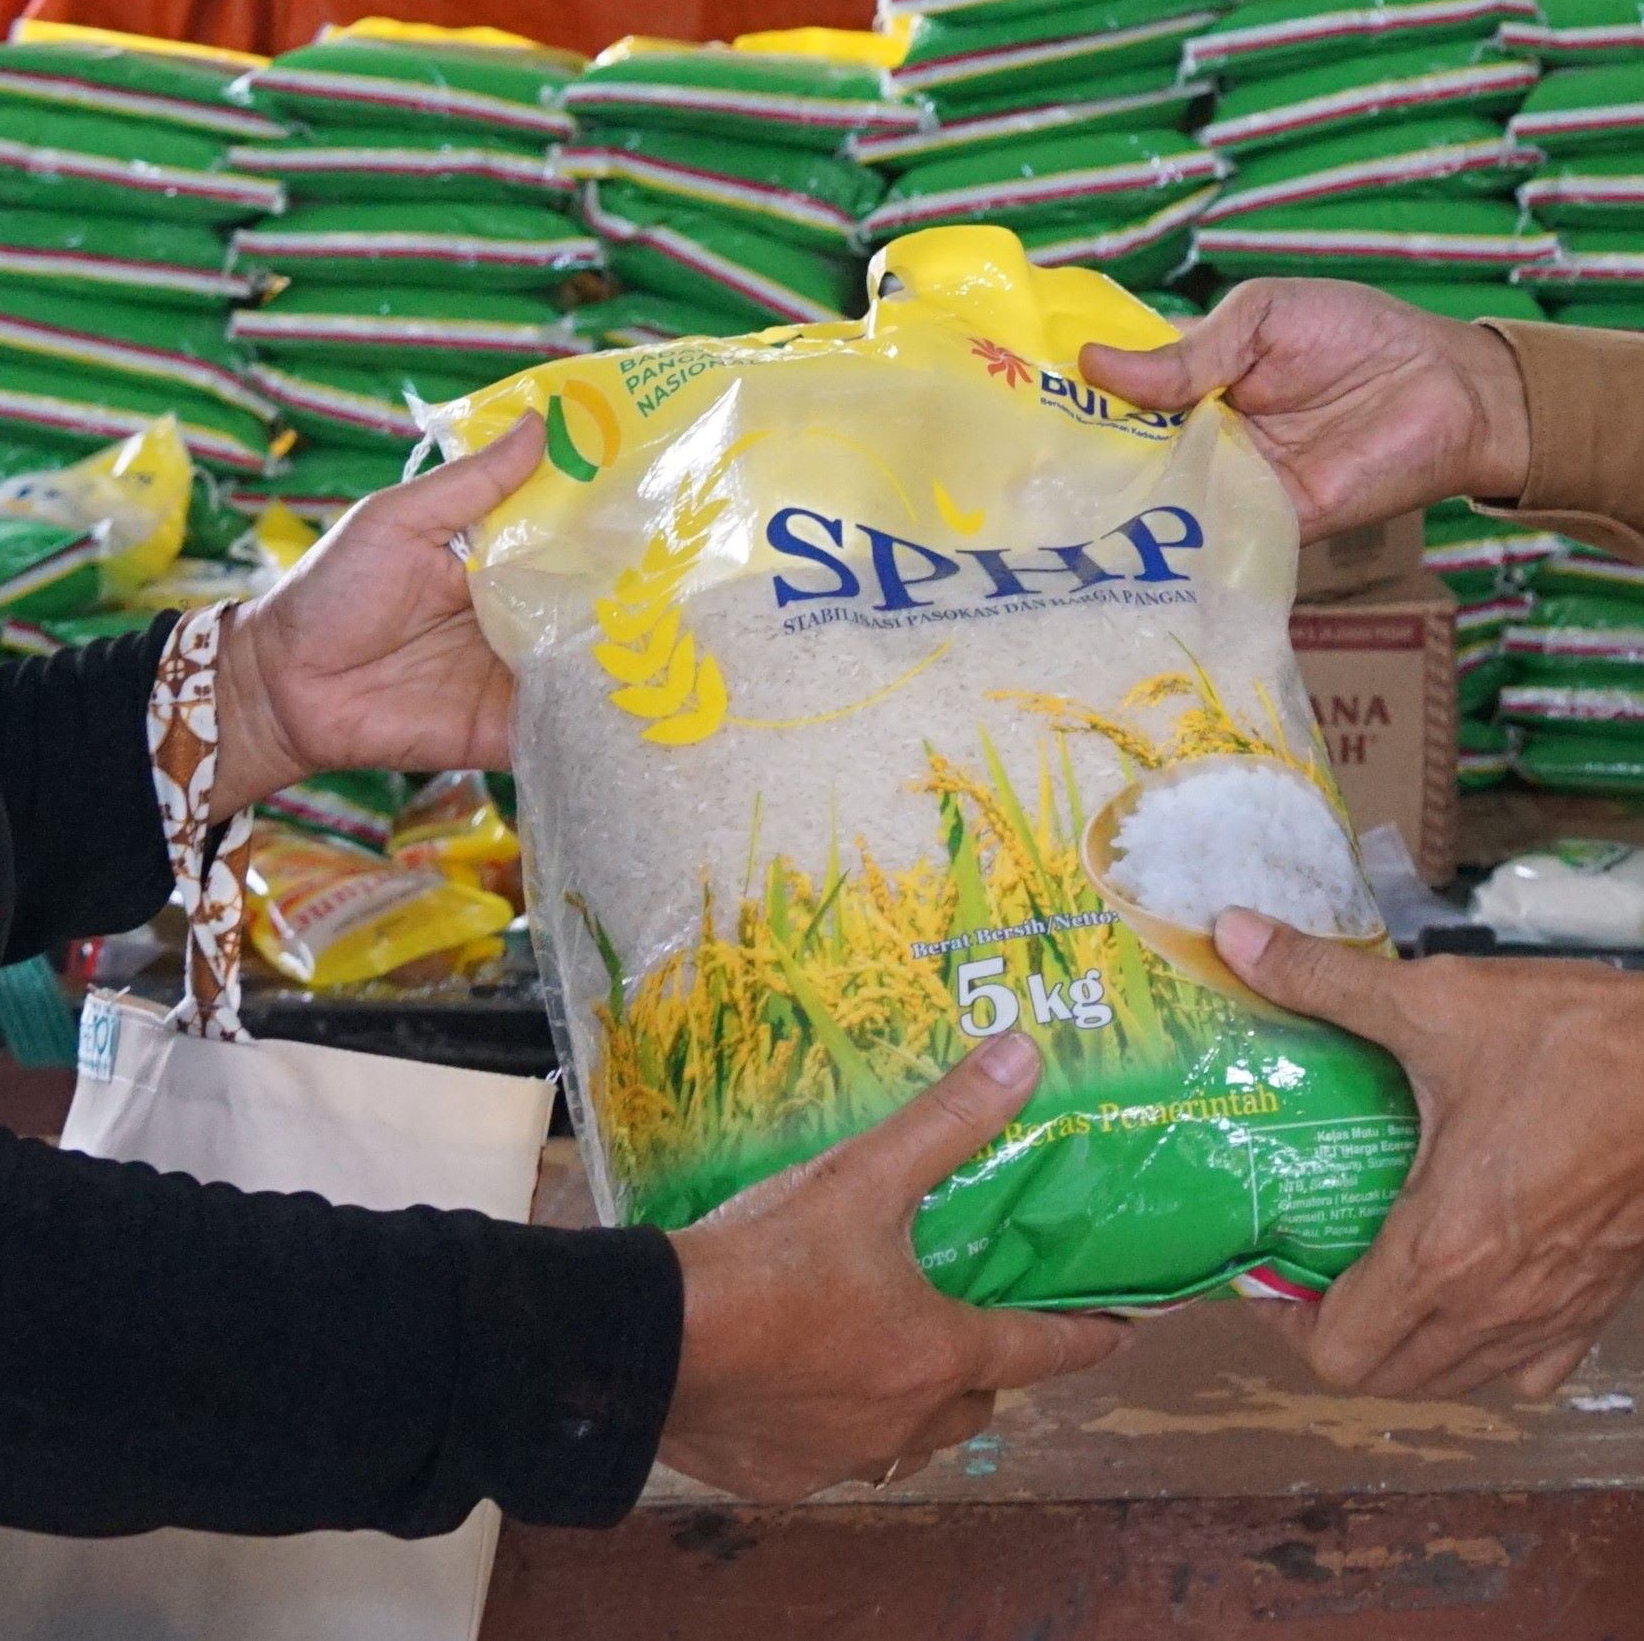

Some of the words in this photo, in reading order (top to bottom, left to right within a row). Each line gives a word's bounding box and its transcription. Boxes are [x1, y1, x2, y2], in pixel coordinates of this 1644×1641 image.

[766, 506, 1204, 611] SPHP
[783, 606, 901, 636] STABILISASI
[907, 606, 1001, 628] PASOKAN
[1005, 598, 1047, 614] DAN
[1049, 588, 1120, 607] HARGA
[1123, 589, 1199, 607] PANGAN
[911, 934, 971, 959] Berat
[975, 910, 1120, 946] Bersih/Netto:
[957, 956, 1020, 1038] 5
[1026, 967, 1114, 1030] kg
[1004, 1113, 1091, 1148] Beras
[1098, 1084, 1280, 1133] Pemerintah
[916, 1248, 958, 1269] OTO
